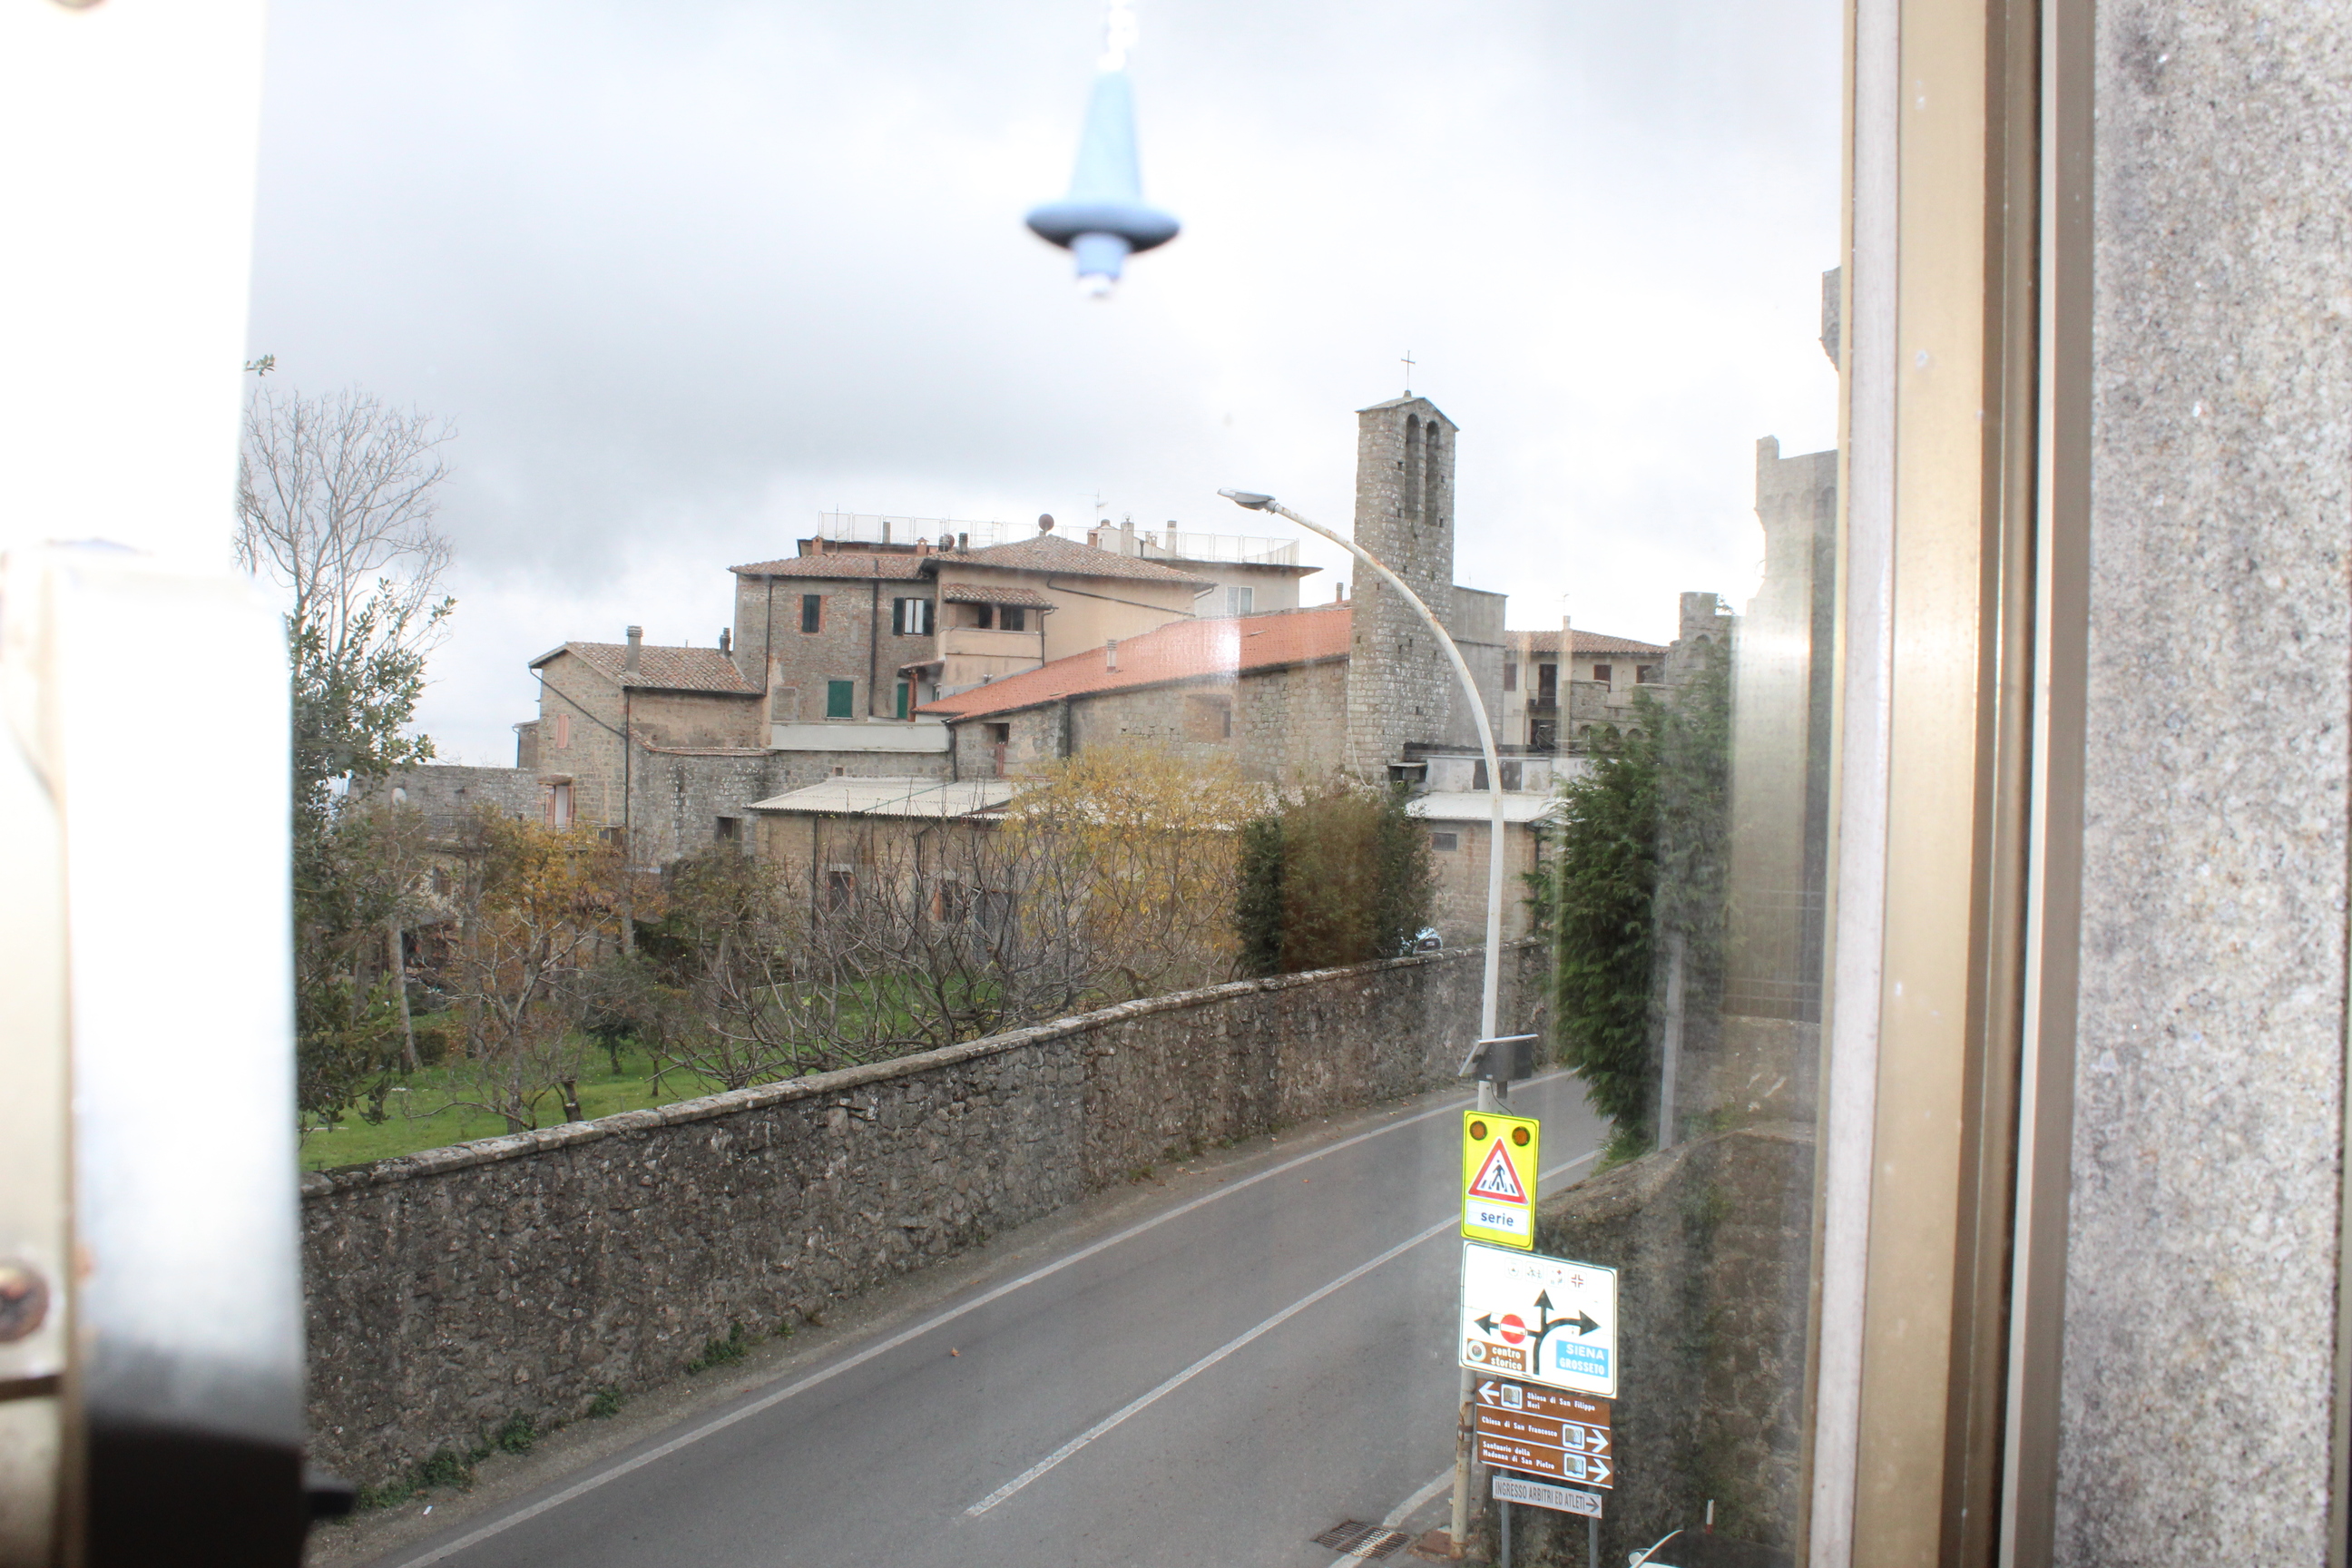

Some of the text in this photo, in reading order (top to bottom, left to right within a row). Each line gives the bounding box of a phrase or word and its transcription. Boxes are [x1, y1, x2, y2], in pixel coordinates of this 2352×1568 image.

[1481, 1212, 1514, 1227] serie
[1492, 1347, 1521, 1359] centro
[1565, 1343, 1604, 1360] SIENA
[1491, 1356, 1523, 1370] storico
[1559, 1357, 1605, 1375] GROSSETO
[1526, 1400, 1540, 1410] Neri
[1549, 1396, 1556, 1404] di
[1559, 1397, 1571, 1406] San
[1574, 1400, 1596, 1412] Filippo
[1482, 1416, 1558, 1437] Chiesa di San Francesco
[1483, 1441, 1531, 1456] Santuario della
[1483, 1449, 1555, 1470] Madonna di San Pietro
[1494, 1480, 1585, 1511] INGRESSO ARBITRI ED ATLETI
